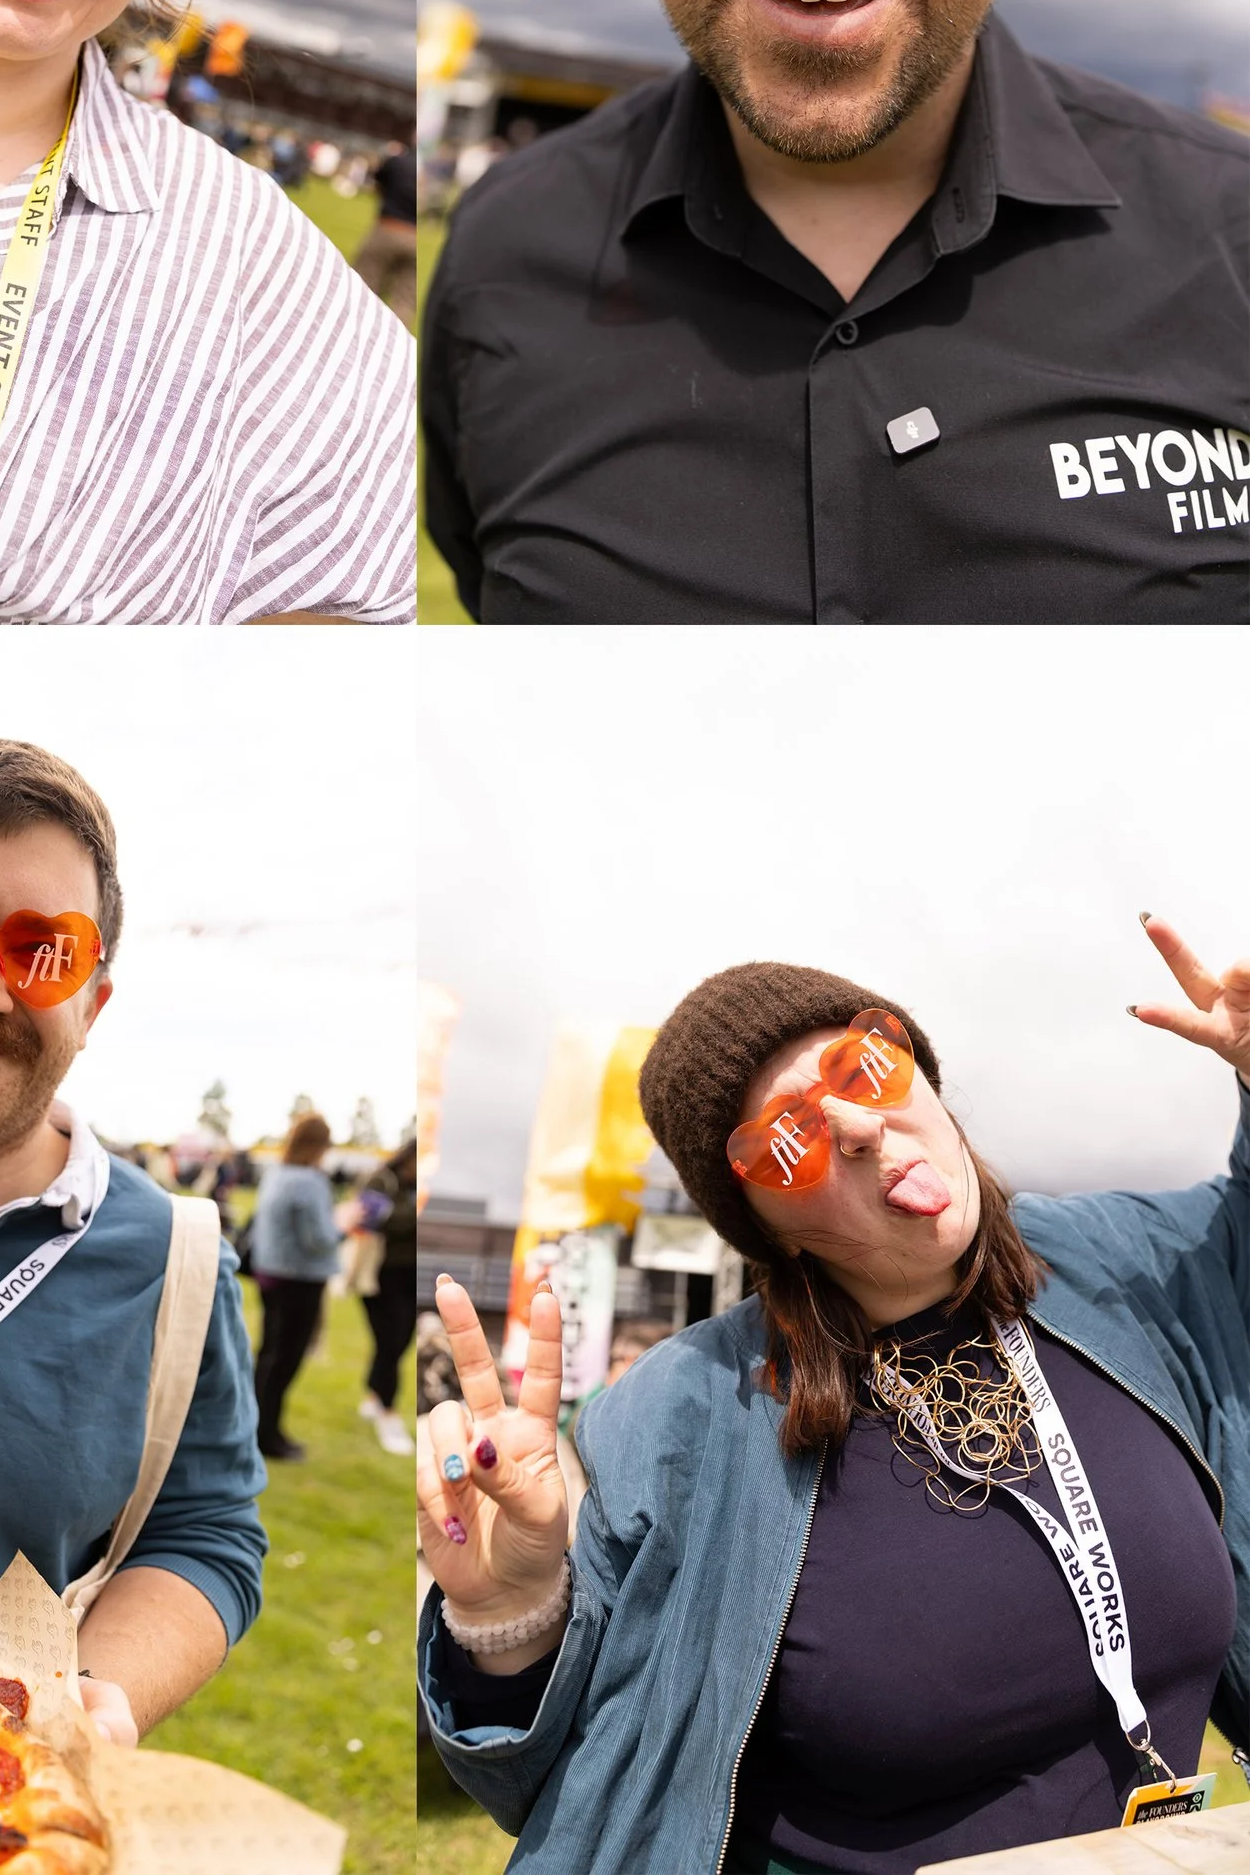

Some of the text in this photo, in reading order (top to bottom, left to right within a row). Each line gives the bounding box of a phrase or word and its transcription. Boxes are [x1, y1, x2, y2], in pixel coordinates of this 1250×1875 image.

[20, 185, 50, 247] STAFF
[1049, 428, 1250, 500] BEYOND
[1003, 1322, 1051, 1413] FOUNDERS
[1048, 1433, 1125, 1652] SQUARE WORKS
[1149, 1801, 1189, 1817] FOUNDERS
